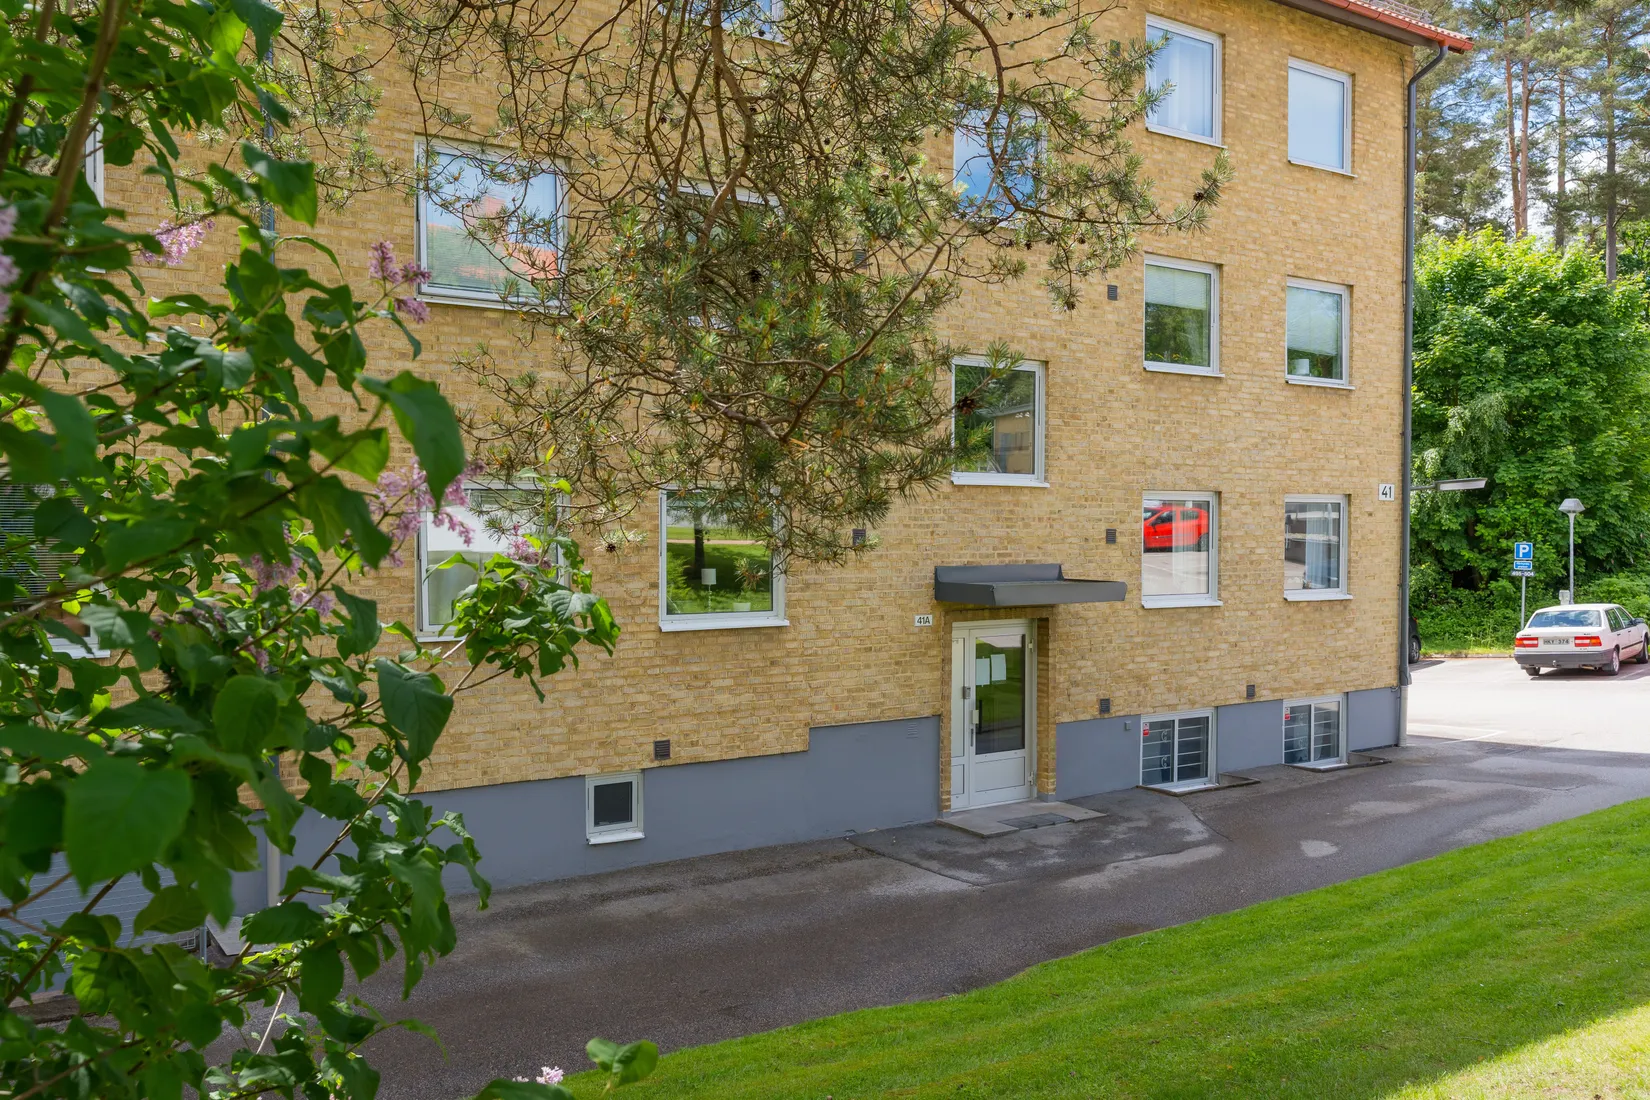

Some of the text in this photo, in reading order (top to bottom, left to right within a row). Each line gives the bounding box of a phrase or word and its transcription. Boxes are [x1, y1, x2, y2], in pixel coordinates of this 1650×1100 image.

[1381, 485, 1392, 499] 41
[1519, 544, 1530, 558] P
[916, 616, 931, 625] 41A
